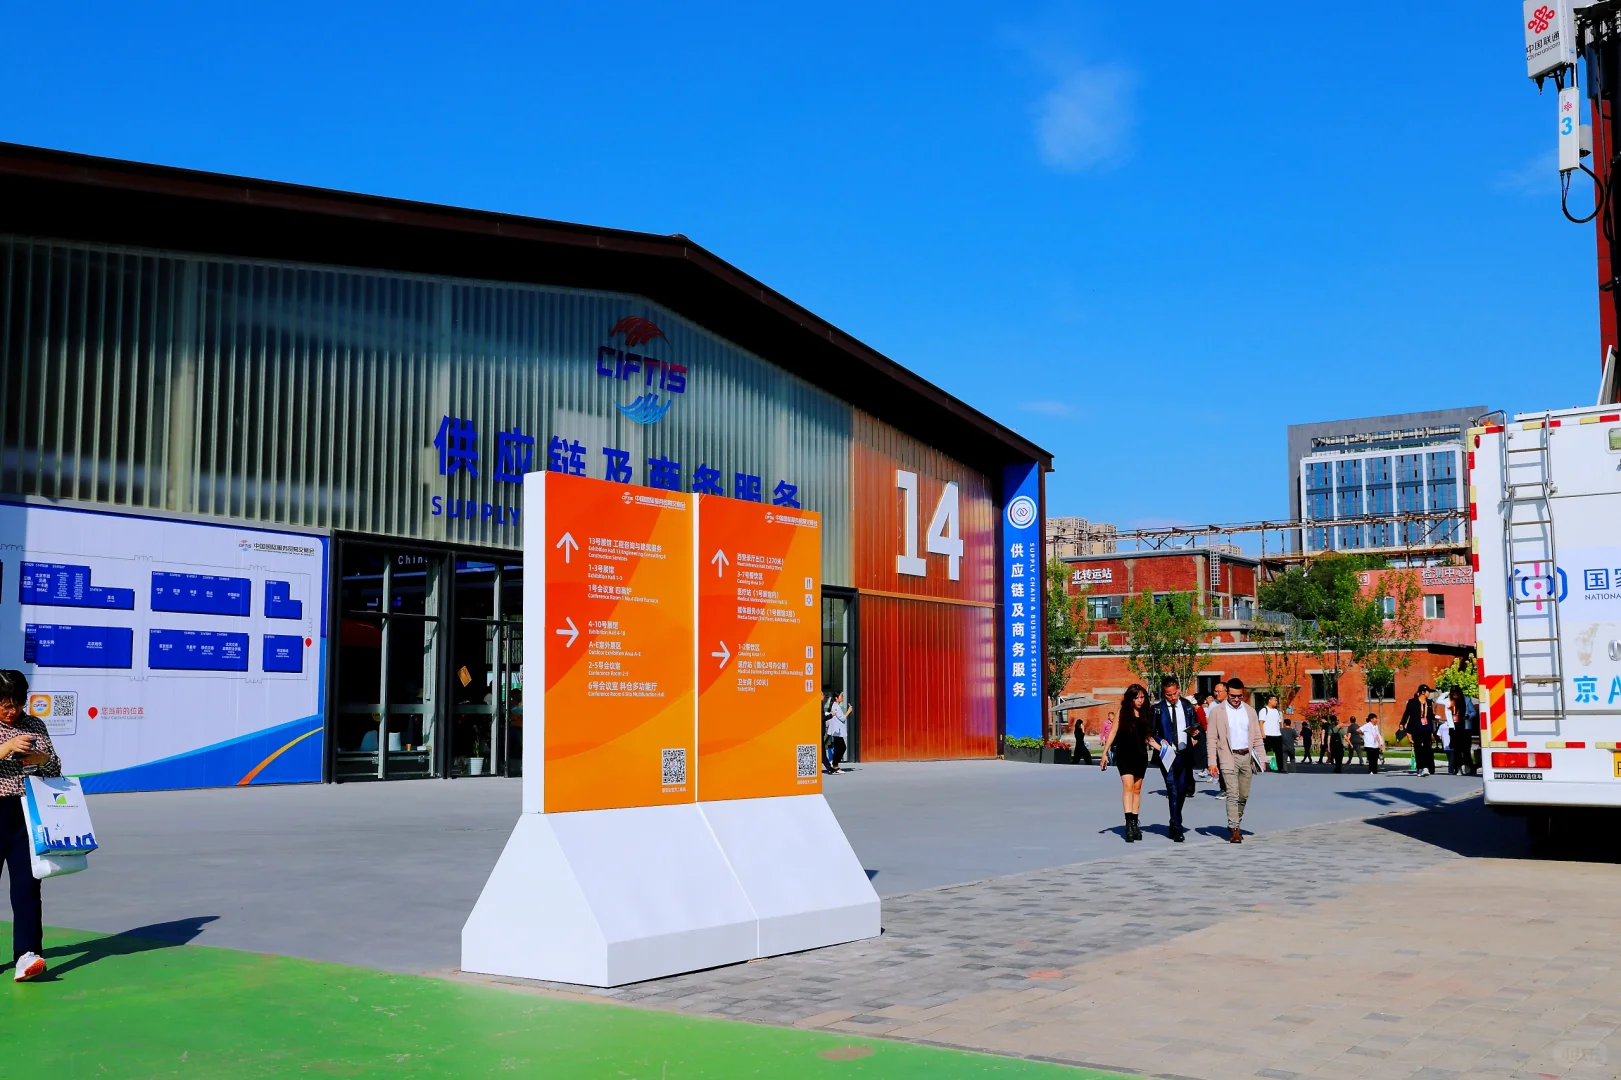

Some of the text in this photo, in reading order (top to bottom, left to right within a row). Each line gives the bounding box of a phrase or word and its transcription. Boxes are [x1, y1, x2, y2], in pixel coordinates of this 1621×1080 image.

[1526, 30, 1560, 53] 中国联通
[1561, 116, 1573, 136] 3
[596, 346, 688, 394] CIFTIS
[433, 415, 800, 509] 供应链及商务服务
[431, 495, 521, 526] SUPPLY
[897, 470, 963, 580] 14
[588, 537, 662, 552] 13号展馆 工程咨询与建筑服务
[397, 554, 428, 565] Chin
[588, 564, 615, 574] 1-3号展馆
[1072, 567, 1112, 580] 北转运站
[1423, 578, 1450, 586] TESTING
[1584, 568, 1621, 591] 国
[588, 584, 614, 594] 1号会议室
[588, 620, 619, 630] 4-10号展馆
[1010, 543, 1026, 697] 供应链及商务服务
[588, 641, 622, 650] A-E室外展区
[588, 661, 621, 670] 2-5号会议室
[588, 680, 658, 692] 6号会议室 料仓多功能厅
[101, 707, 144, 715] 您当前的位置
